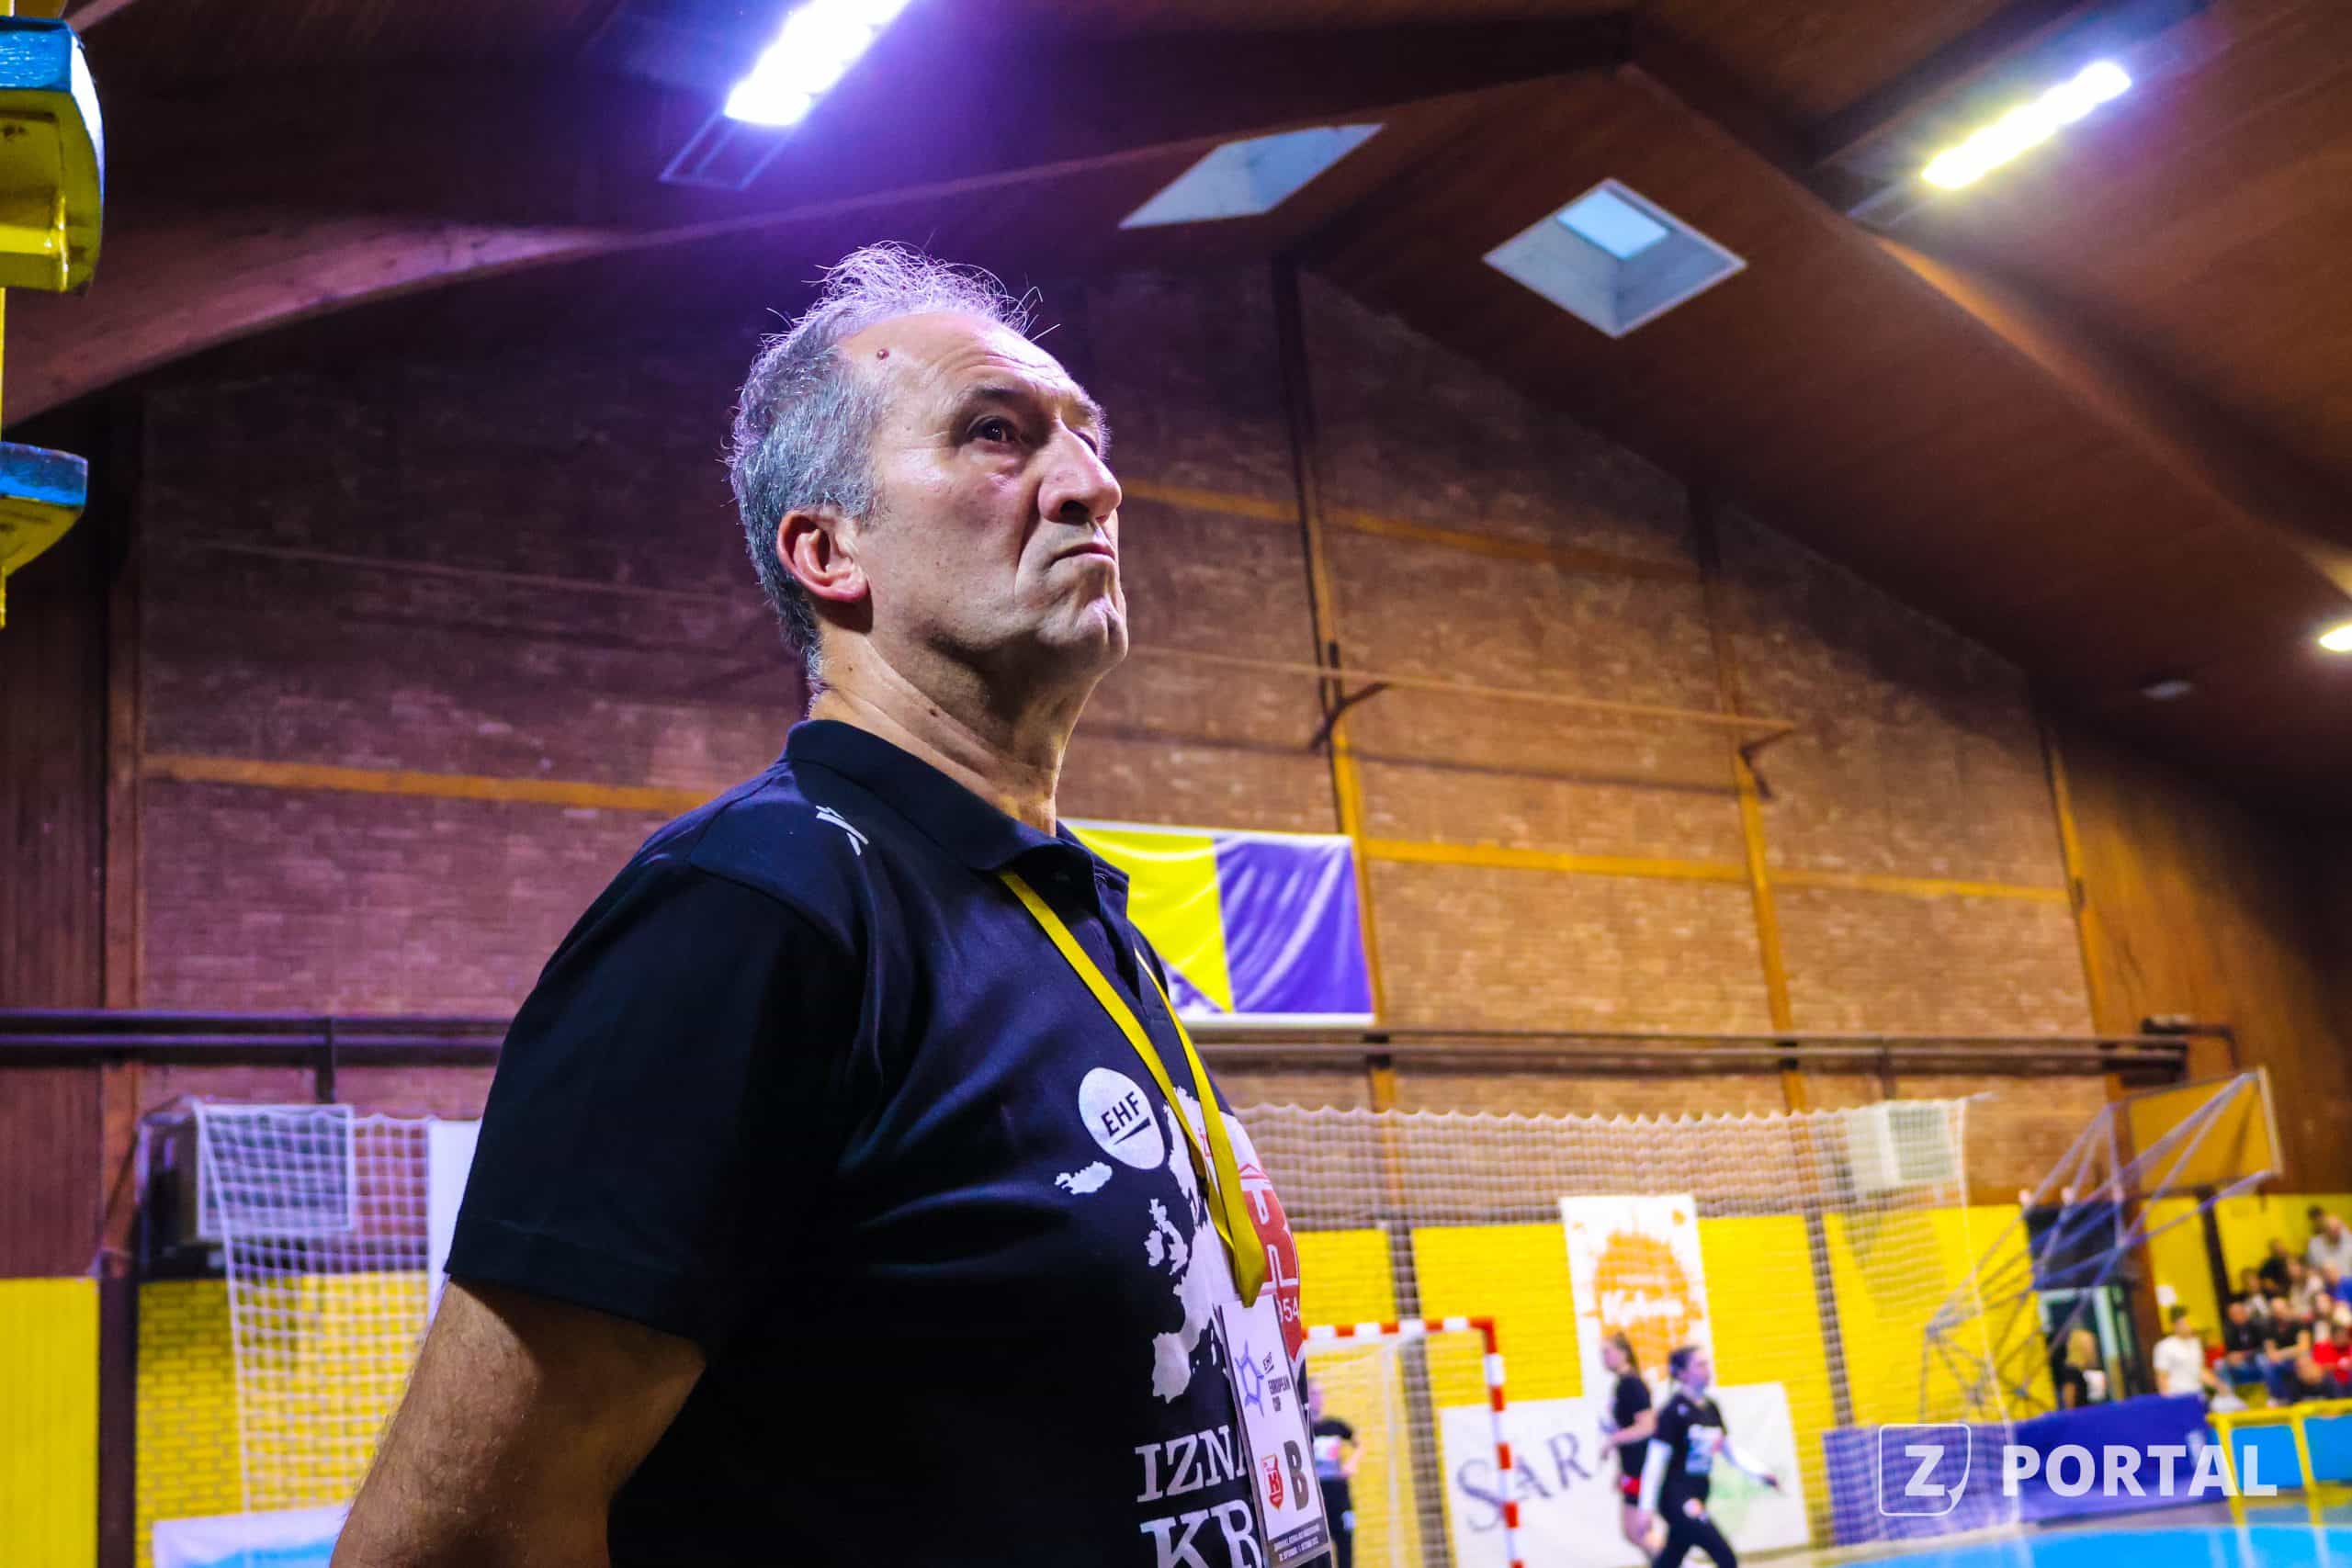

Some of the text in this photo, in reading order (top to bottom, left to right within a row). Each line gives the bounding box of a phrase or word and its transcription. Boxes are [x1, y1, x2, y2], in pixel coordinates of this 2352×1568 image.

[1101, 1090, 1139, 1137] EHF
[1278, 1296, 1299, 1324] 54
[1262, 1351, 1272, 1371] EHF
[1283, 1440, 1309, 1511] B
[1456, 1417, 1617, 1533] SAR
